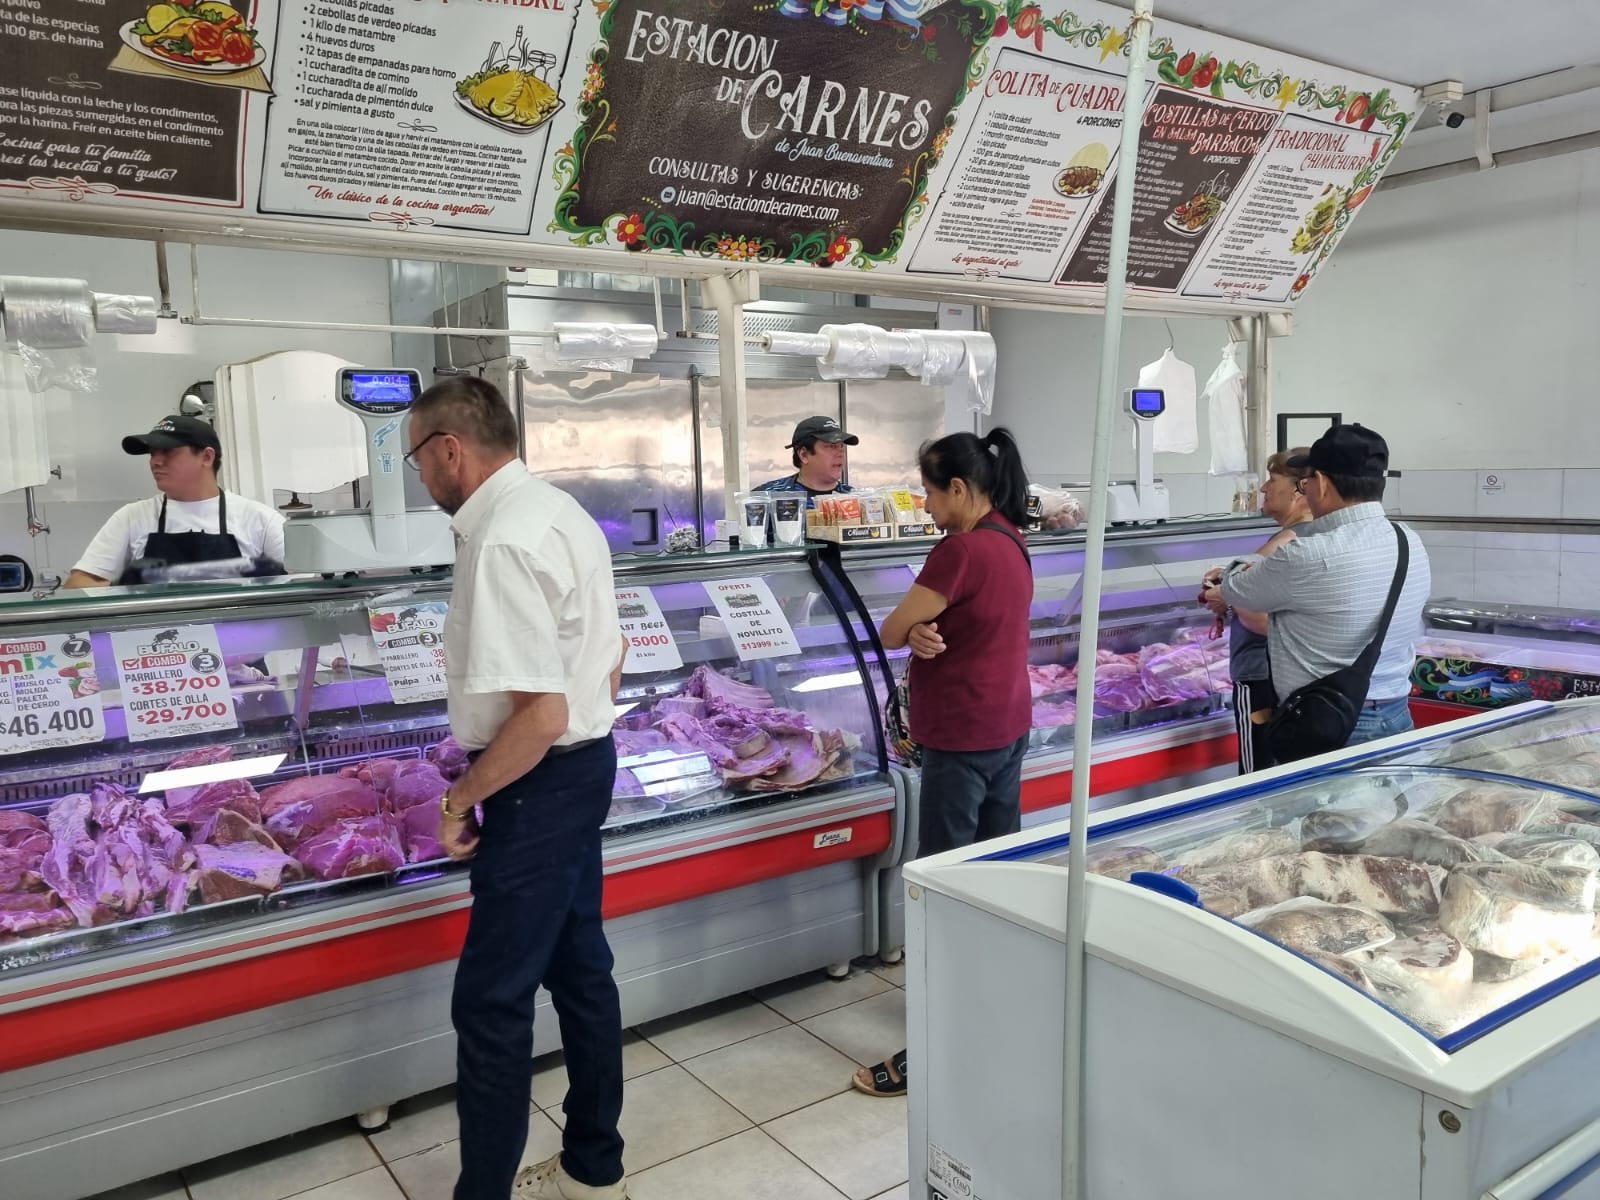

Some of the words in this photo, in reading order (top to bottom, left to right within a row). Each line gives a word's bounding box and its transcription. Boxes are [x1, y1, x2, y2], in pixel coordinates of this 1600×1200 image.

[359, 2, 393, 14] picadas
[15, 11, 30, 22] de
[32, 13, 49, 25] las
[51, 19, 99, 33] especias
[309, 4, 315, 14] 2
[317, 7, 355, 21] cebollas
[357, 13, 369, 24] de
[371, 17, 401, 30] verdeo
[402, 23, 436, 36] picadas
[311, 18, 314, 27] 1
[316, 19, 333, 31] kilo
[334, 23, 346, 33] de
[348, 27, 395, 42] matambre
[5, 24, 26, 36] 100
[28, 30, 49, 40] grs.
[51, 31, 65, 42] de
[68, 33, 103, 48] harina
[306, 32, 313, 41] 4
[315, 33, 348, 47] huevos
[349, 39, 374, 52] duros
[624, 10, 779, 74] ESTACION
[305, 58, 307, 67] 1
[309, 61, 363, 76] cucharadita
[365, 68, 376, 78] de
[377, 72, 409, 83] comino
[306, 45, 315, 55] 12
[317, 47, 342, 59] tapas
[344, 52, 356, 62] de
[357, 56, 409, 71] empanadas
[410, 65, 430, 74] para
[432, 66, 456, 78] horno
[303, 72, 306, 80] 1
[308, 74, 361, 89] cucharadita
[363, 81, 374, 91] de
[375, 84, 387, 94] ají
[388, 86, 417, 97] molido
[985, 69, 1049, 98] COLITA
[1049, 82, 1062, 95] DE
[1056, 82, 1126, 113] CUADRI
[21, 87, 59, 101] líquida
[61, 95, 81, 104] con
[83, 95, 93, 106] la
[95, 97, 123, 110] leche
[126, 103, 131, 112] y
[133, 102, 148, 113] los
[150, 107, 218, 123] condimentos,
[299, 98, 313, 107] sal
[315, 101, 320, 109] y
[321, 101, 361, 114] pimienta
[370, 109, 394, 119] gusto
[302, 84, 305, 93] 1
[306, 87, 353, 100] cucharada
[355, 92, 366, 102] de
[367, 95, 409, 109] pimentón
[411, 101, 433, 112] dulce
[20, 101, 36, 112] las
[38, 104, 73, 117] piezas
[75, 110, 136, 124] sumergidas
[138, 118, 151, 126] en
[153, 119, 162, 127] el
[164, 122, 223, 135] condimento
[716, 76, 746, 104] DE
[741, 69, 932, 150] CARNES
[1143, 103, 1220, 127] COSTILLAS
[1218, 113, 1232, 126] DE
[1229, 110, 1276, 133] CERDO
[20, 115, 30, 125] la
[73, 121, 96, 132] Freír
[98, 126, 111, 134] en
[113, 128, 145, 138] aceite
[147, 130, 169, 141] bien
[170, 134, 212, 146] caliente.
[1082, 116, 1123, 128] PORCIONES
[1153, 126, 1167, 139] EN
[1167, 127, 1199, 140] SALSA
[1190, 132, 1262, 155] BARBACOA
[1267, 129, 1349, 153] TRADICIONAL
[44, 143, 80, 156] para
[85, 143, 103, 156] tu
[102, 145, 151, 161] familia
[775, 138, 790, 153] de
[789, 137, 824, 161] Juan
[824, 143, 894, 168] Buenaventura
[28, 154, 47, 167] las
[52, 159, 101, 172] recetas
[117, 163, 135, 175] tu
[649, 156, 739, 185] CONSULTAS
[747, 169, 758, 187] Y
[761, 173, 865, 200] SUGERENCIAS:
[307, 185, 333, 199] Un
[336, 190, 371, 202] clásico
[375, 194, 388, 204] de
[392, 196, 403, 206] la
[406, 199, 439, 209] cocina
[675, 185, 839, 221] juan@estaciondecarnes.com
[718, 583, 752, 591] OFERTA
[730, 609, 771, 619] COSTILLA
[750, 619, 762, 627] DE
[386, 618, 438, 634] BUFALO
[737, 627, 783, 639] NOVILLITO
[6, 641, 43, 654] COMBO
[69, 640, 84, 653] 7
[137, 640, 200, 656] BUFALO
[391, 637, 417, 647] COMBO
[423, 633, 434, 643] 3
[146, 654, 184, 666] COMBO
[199, 654, 215, 667] 3
[15, 680, 45, 688] MUSLO
[124, 669, 184, 683] PARRILLERO
[132, 674, 221, 696] $38.700
[393, 677, 420, 687] Pulpa
[16, 687, 49, 696] MOLIDA
[16, 694, 49, 703] PALETA
[129, 698, 167, 712] CORTES
[170, 696, 183, 707] DE
[185, 693, 209, 705] OLLA
[18, 703, 31, 711] DE
[31, 700, 60, 710] CERDO
[136, 702, 227, 725] $29.700
[0, 706, 95, 738] $46.400
